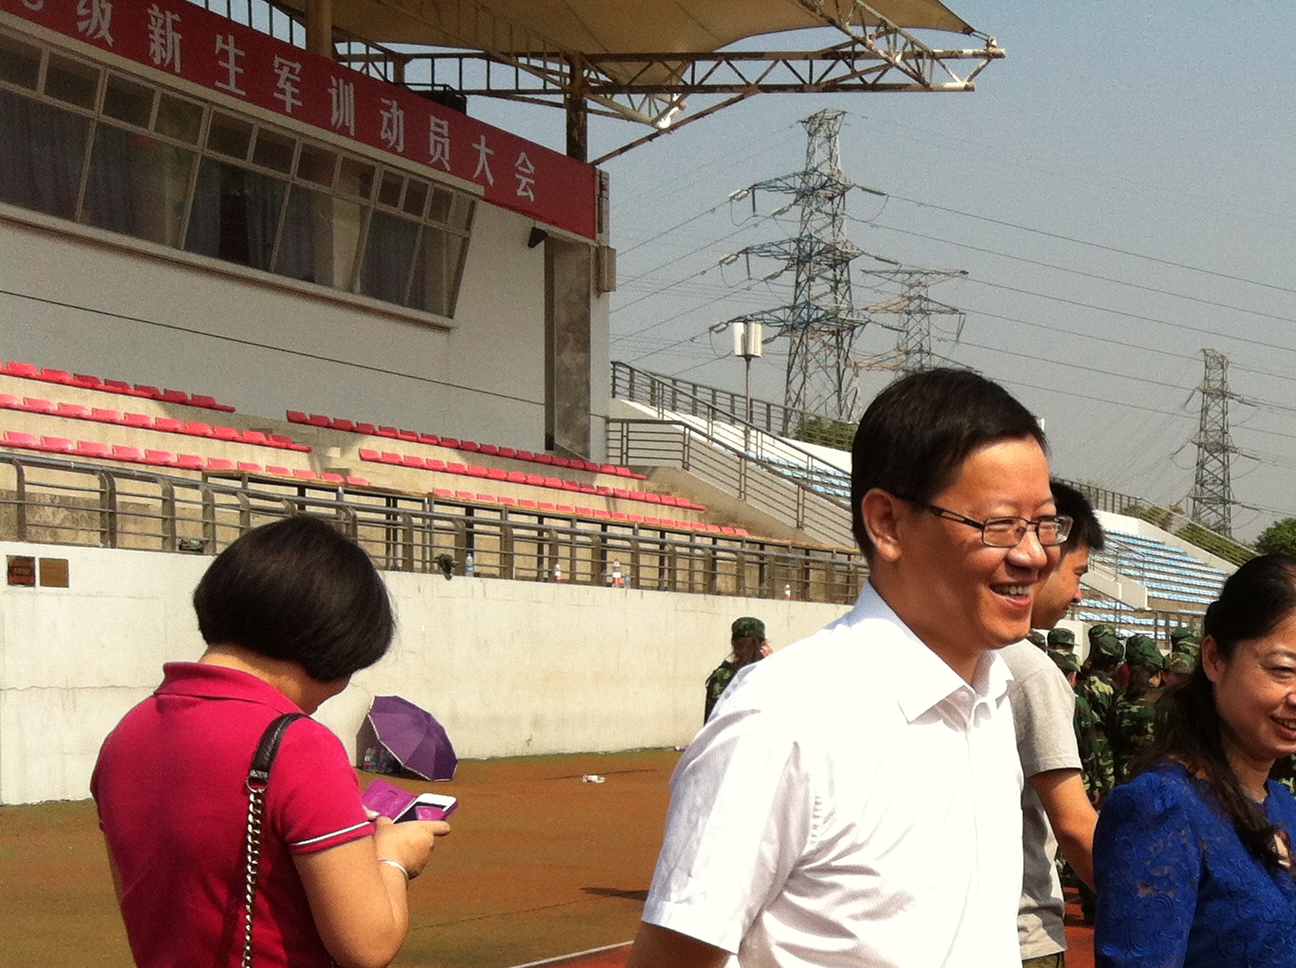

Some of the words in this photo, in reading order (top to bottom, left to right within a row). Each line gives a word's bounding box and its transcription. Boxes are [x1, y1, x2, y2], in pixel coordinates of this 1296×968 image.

[22, 0, 538, 202] 级新生军训动员大会
